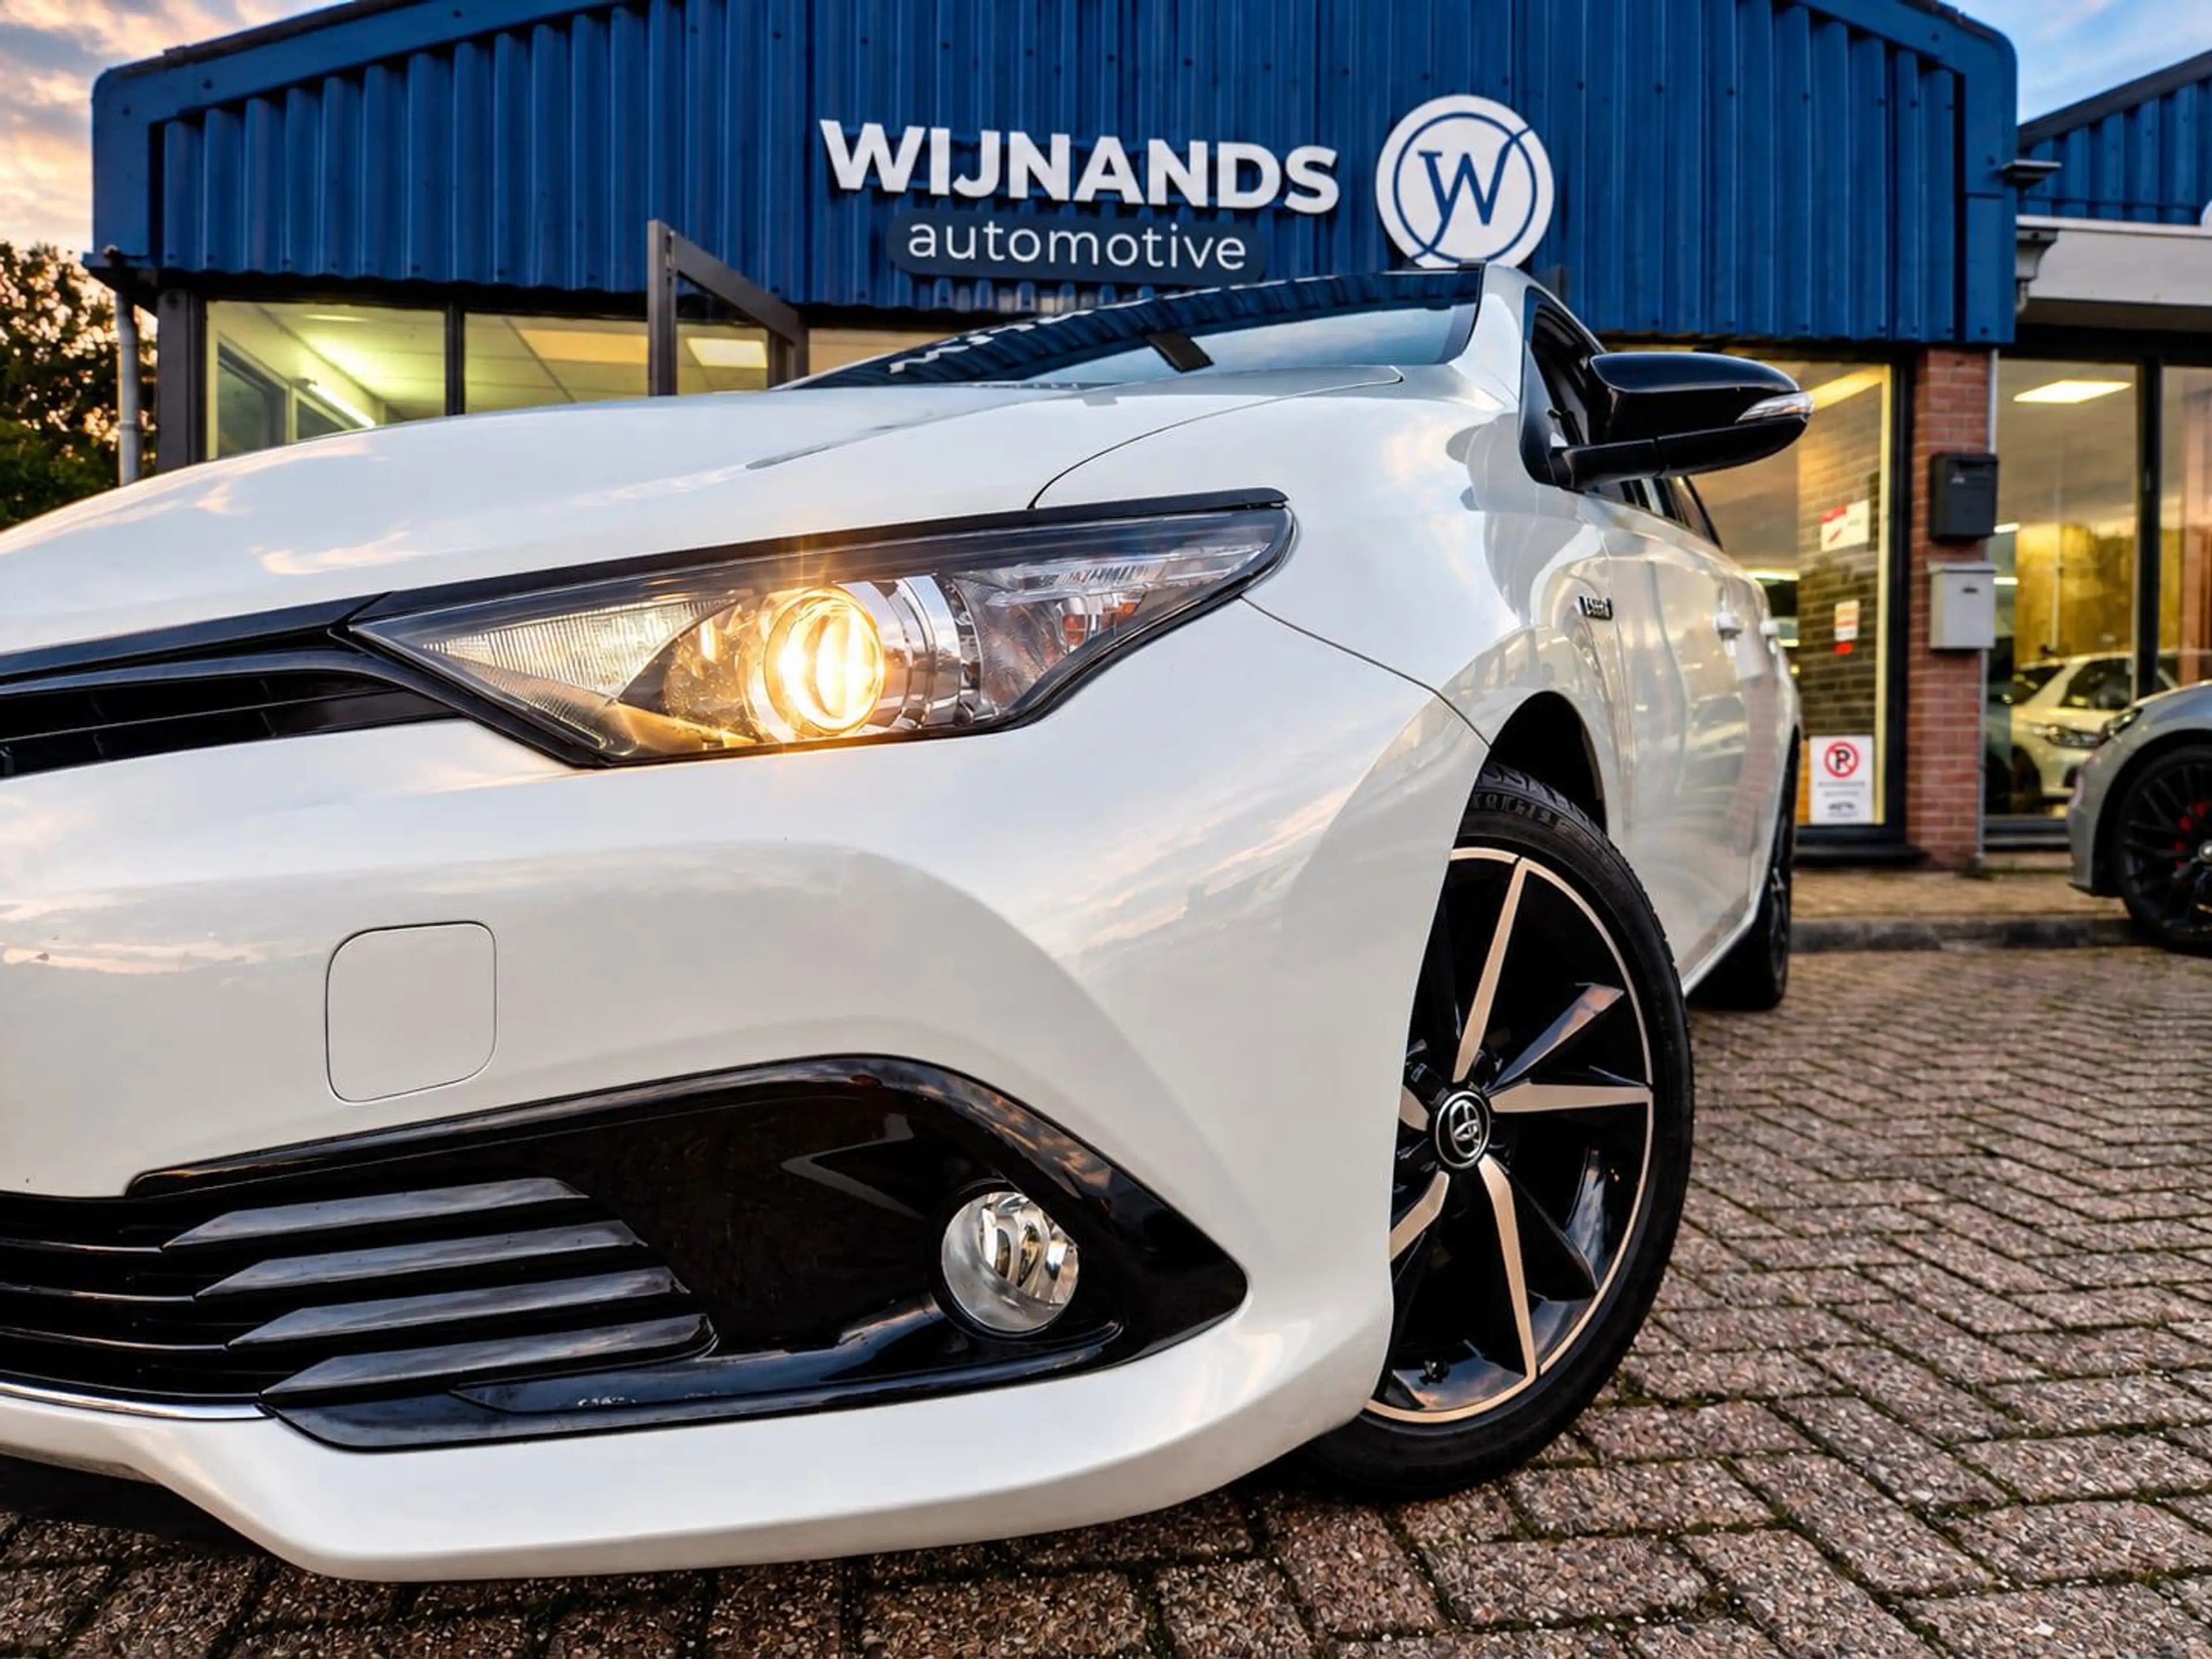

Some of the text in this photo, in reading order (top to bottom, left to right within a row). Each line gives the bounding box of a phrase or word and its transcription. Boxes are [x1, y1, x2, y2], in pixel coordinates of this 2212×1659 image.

[819, 119, 1341, 214] WIJNANDS
[908, 220, 1247, 270] automotive
[1835, 749, 1851, 771] P
